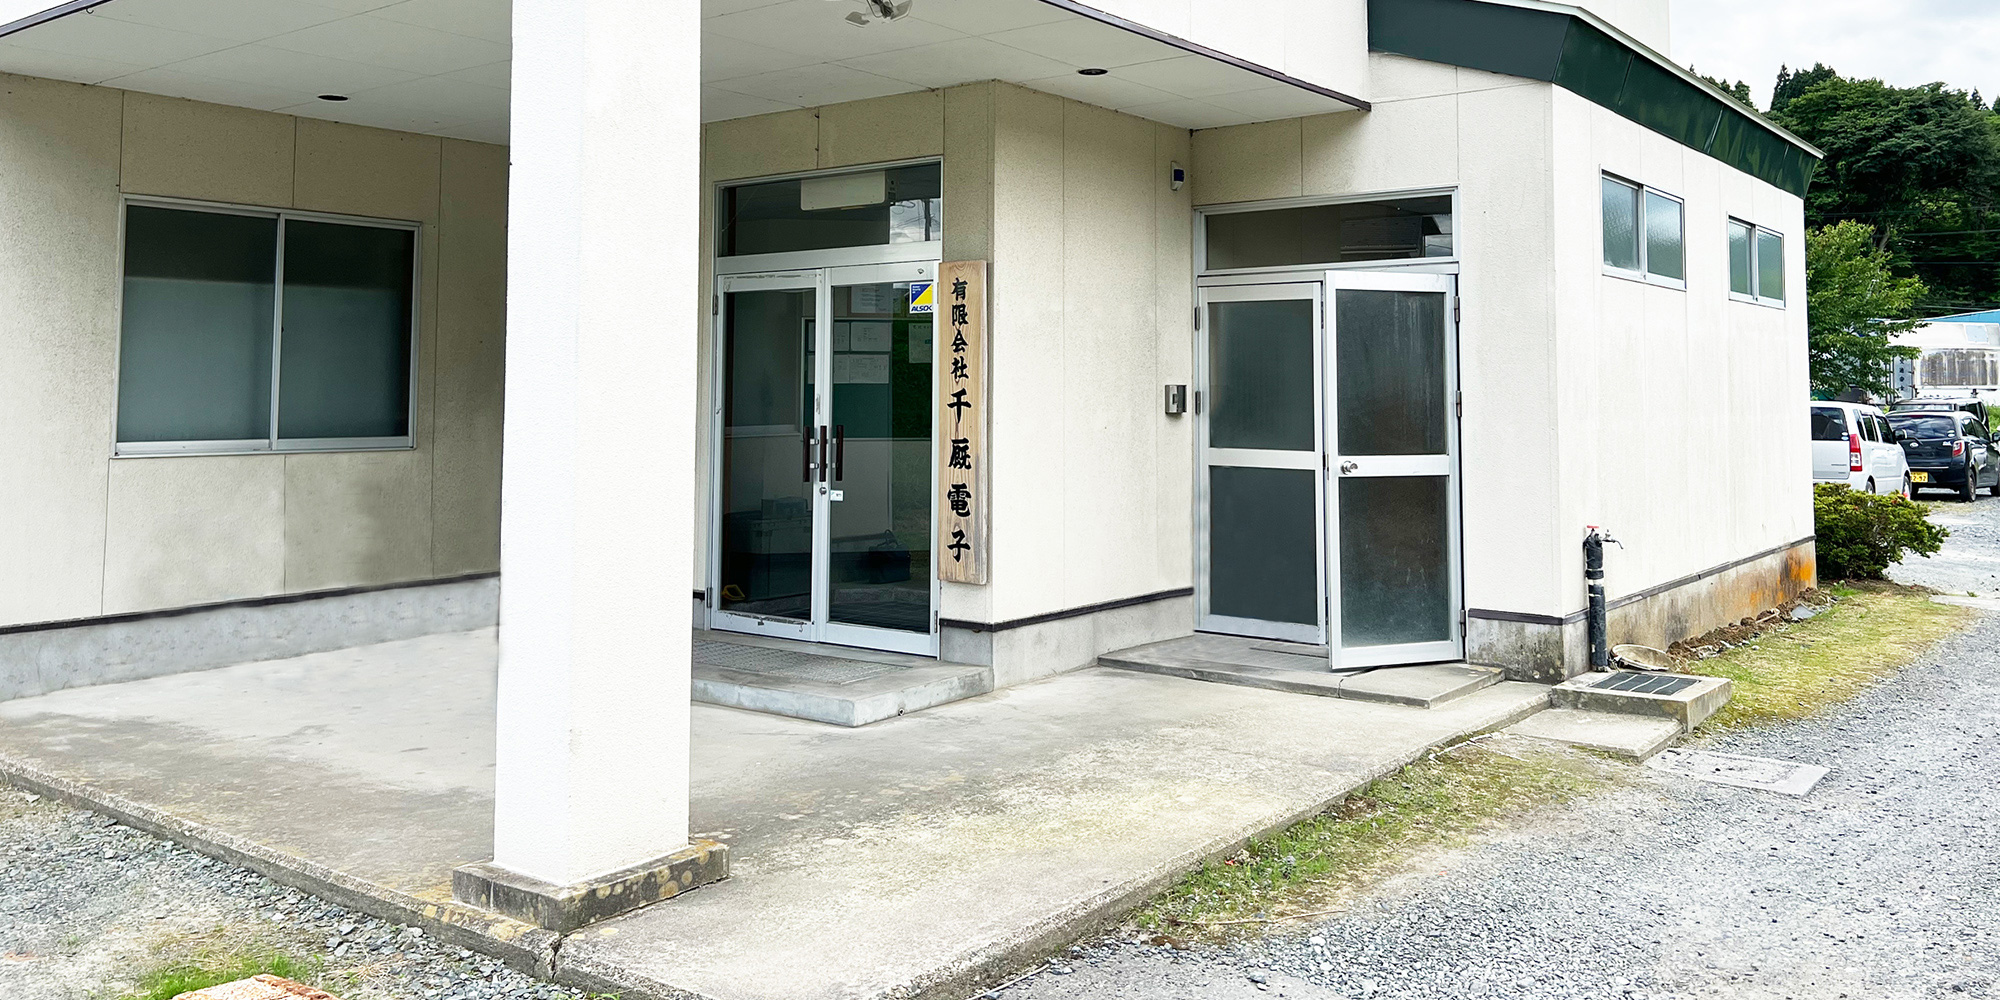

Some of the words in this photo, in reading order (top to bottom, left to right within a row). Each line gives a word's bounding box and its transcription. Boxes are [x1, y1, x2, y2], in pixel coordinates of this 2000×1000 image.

[947, 277, 972, 563] 有限会社千厩電子
